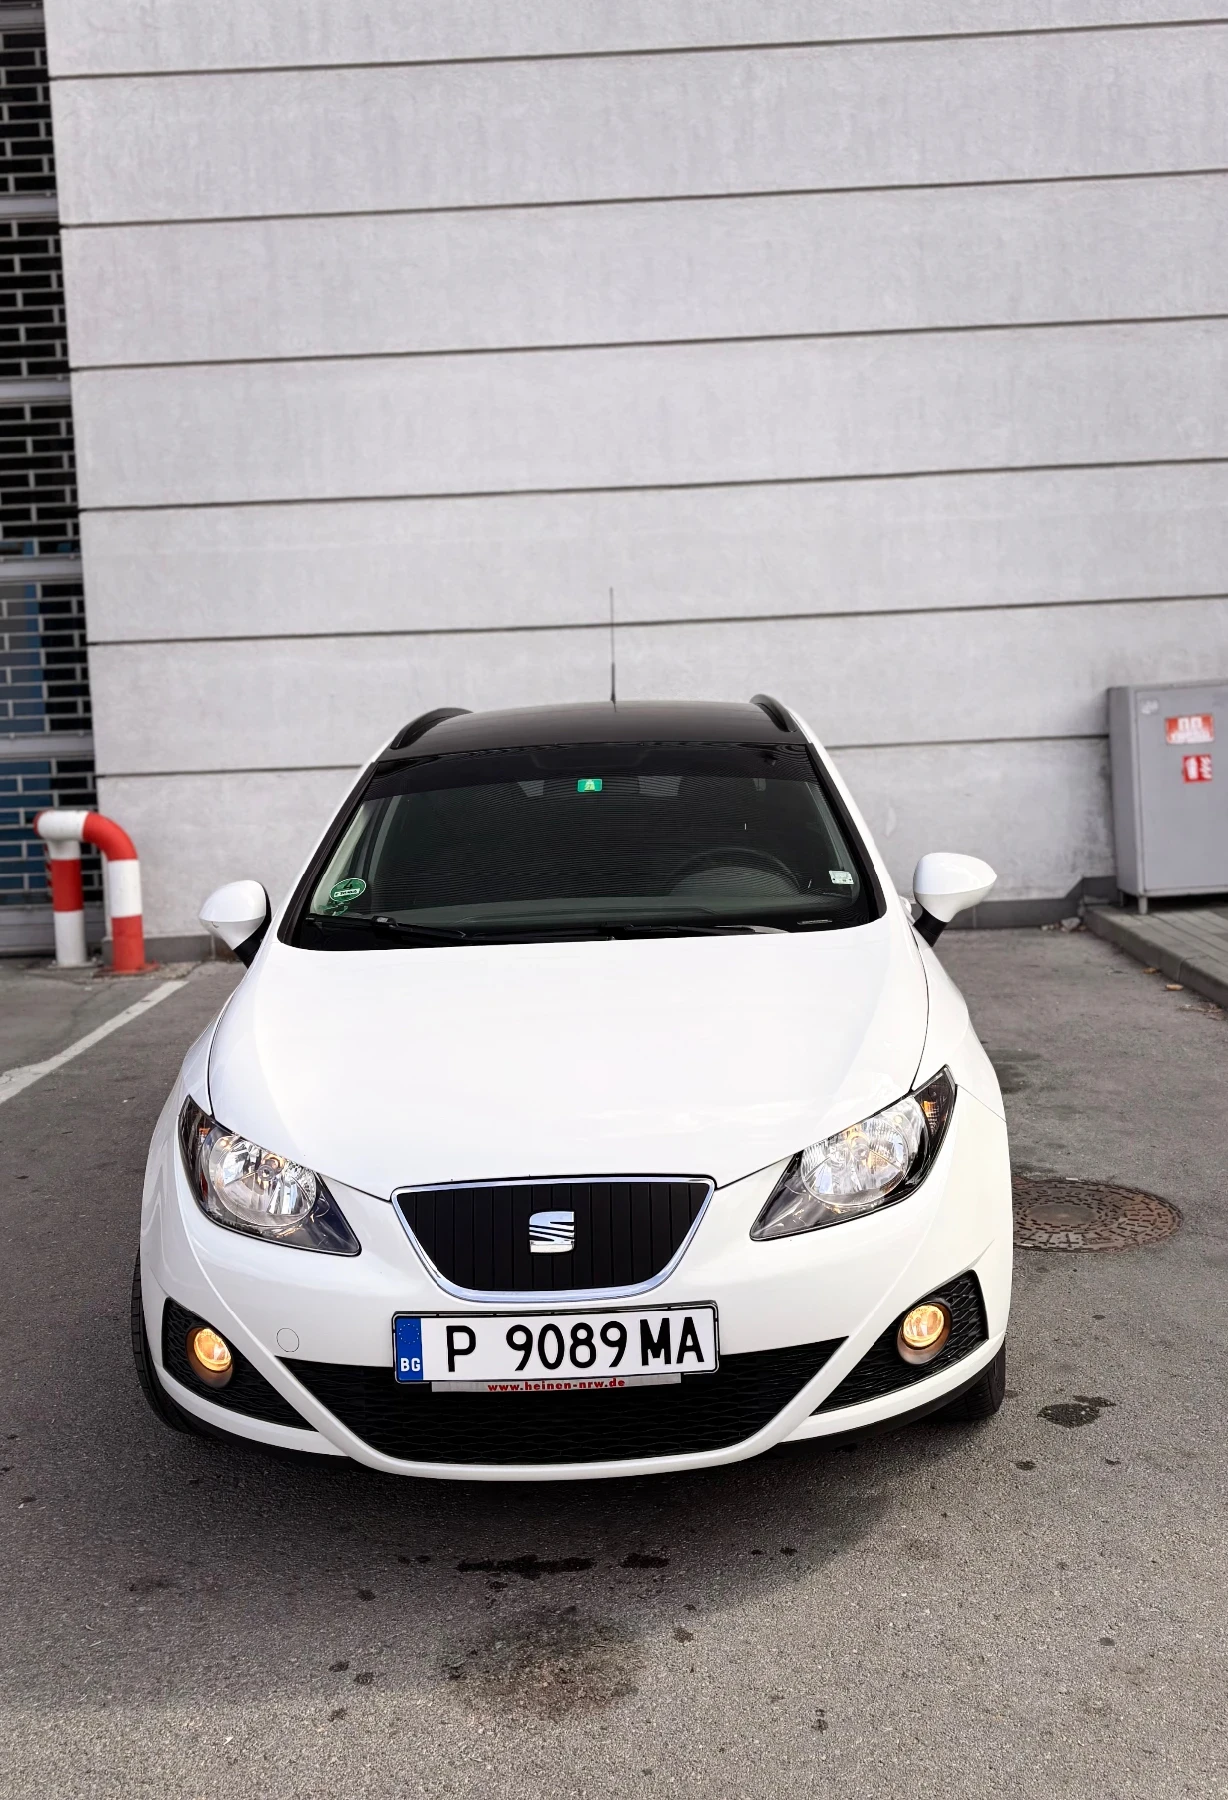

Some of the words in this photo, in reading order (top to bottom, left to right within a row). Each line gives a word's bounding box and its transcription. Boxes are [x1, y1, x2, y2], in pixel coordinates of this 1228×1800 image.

[446, 1325, 476, 1372] P
[505, 1320, 628, 1371] 9089
[639, 1316, 705, 1366] MA
[400, 1357, 421, 1372] BG
[487, 1377, 626, 1392] www.heinen-nrw.de
